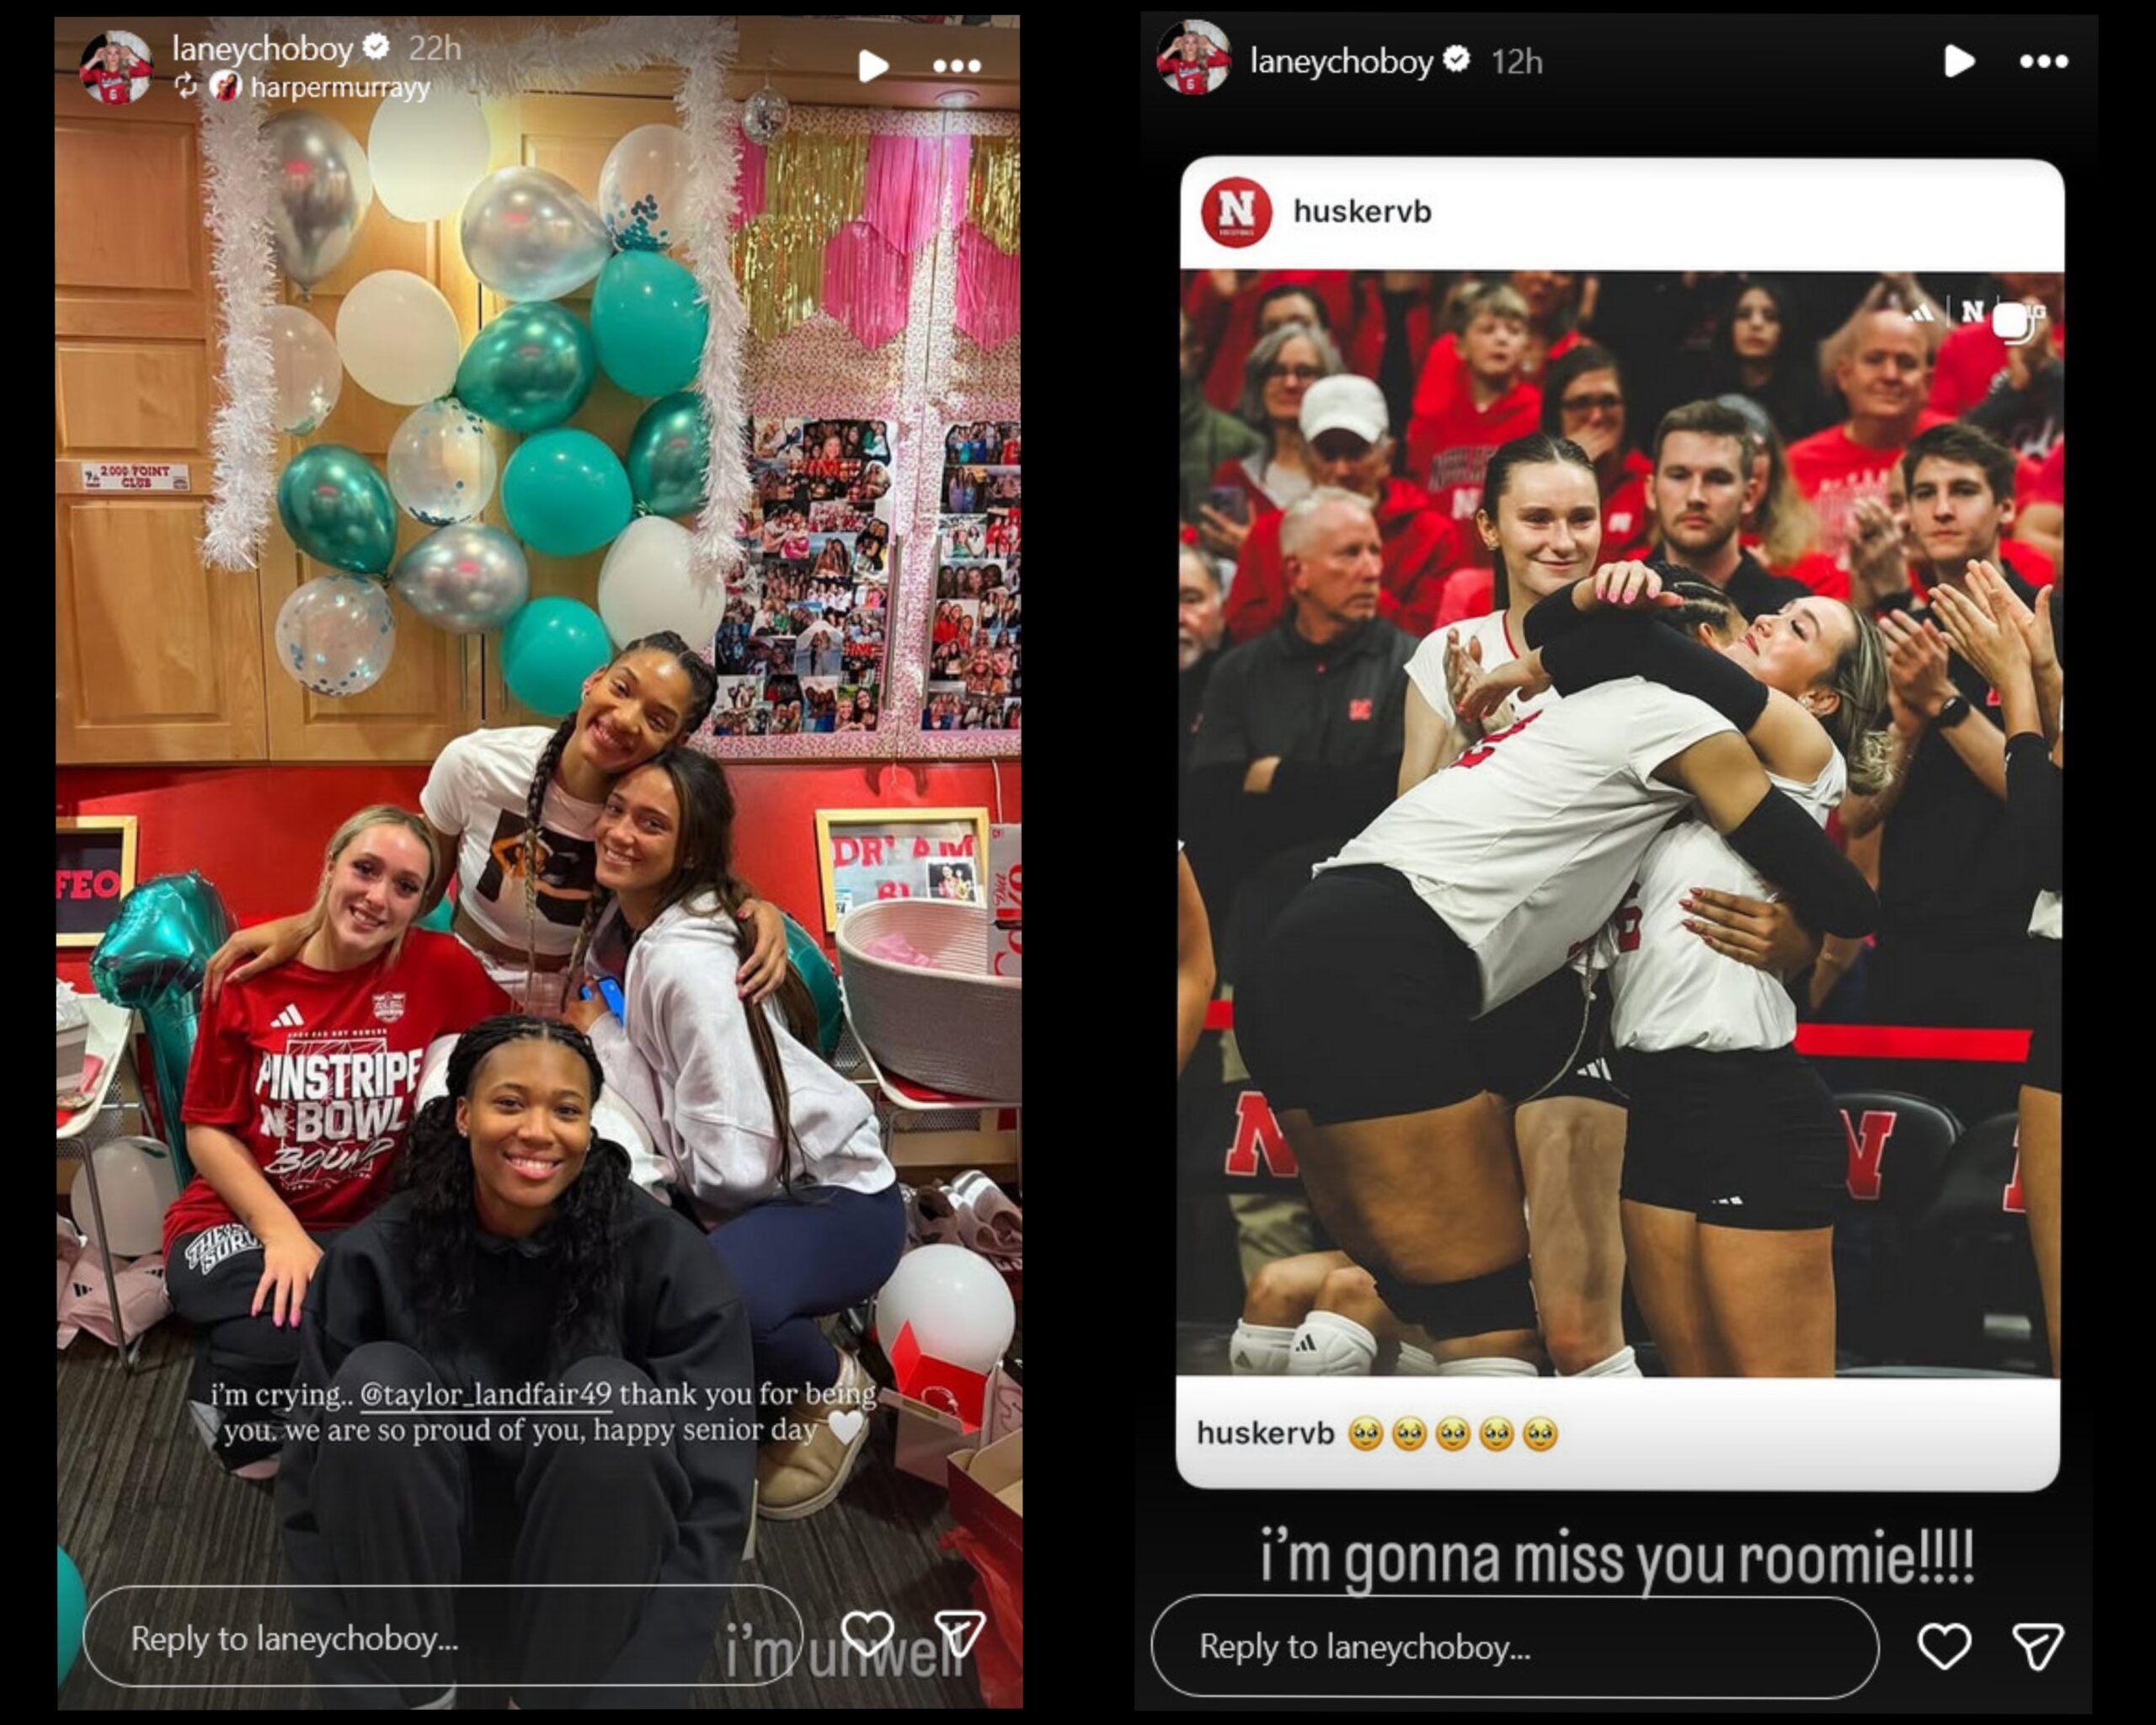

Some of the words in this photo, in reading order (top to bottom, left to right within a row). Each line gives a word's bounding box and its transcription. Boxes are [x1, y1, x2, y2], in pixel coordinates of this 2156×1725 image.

[121, 478, 152, 488] CLUB
[830, 835, 974, 868] DRAM
[296, 1097, 408, 1143] BOWL
